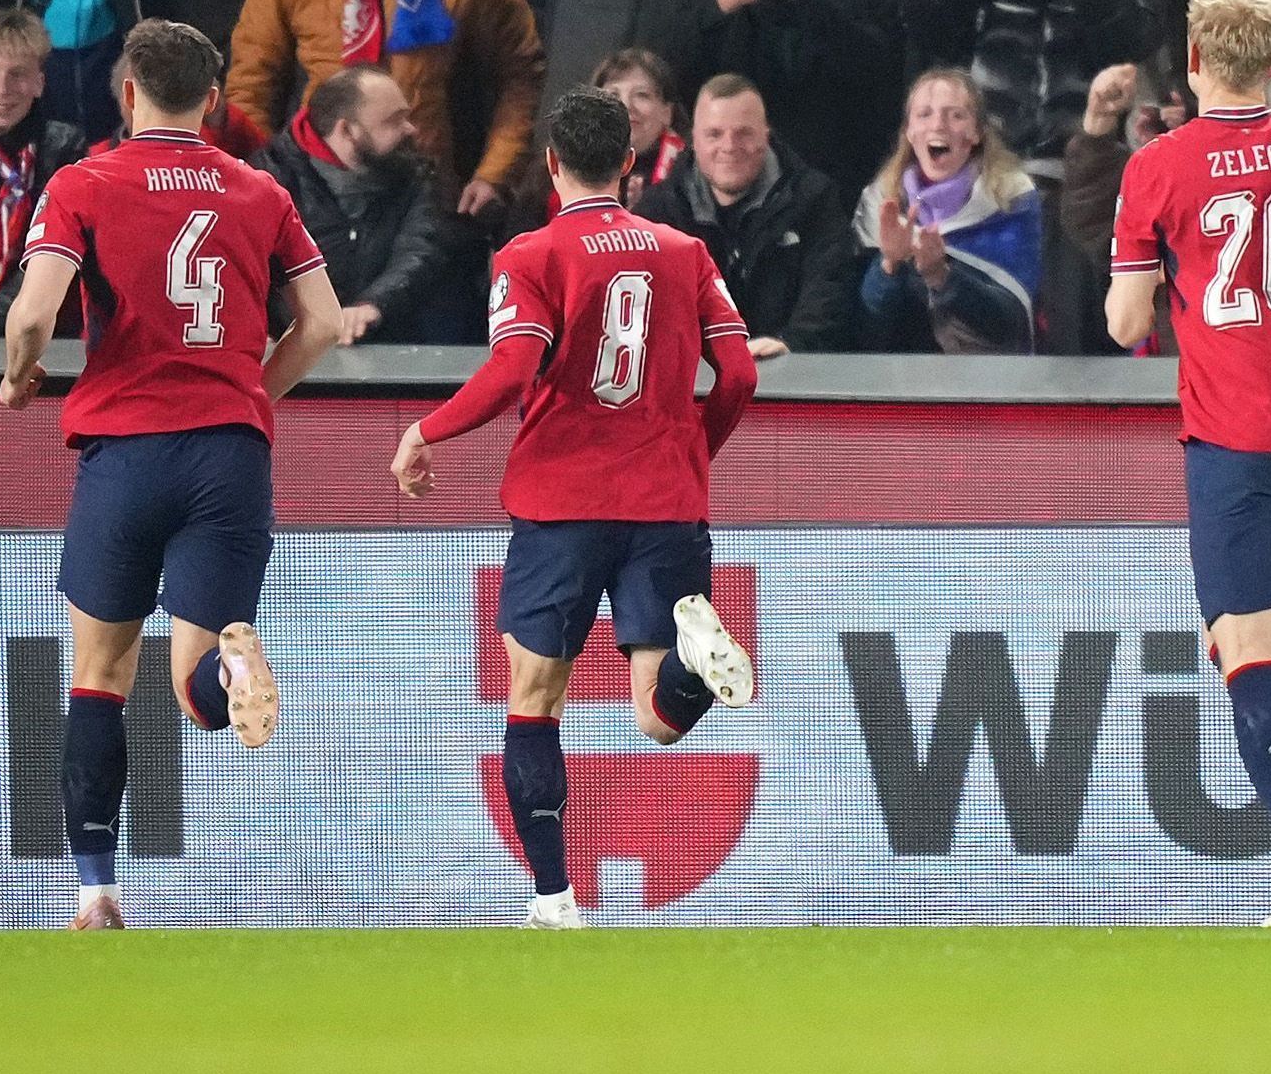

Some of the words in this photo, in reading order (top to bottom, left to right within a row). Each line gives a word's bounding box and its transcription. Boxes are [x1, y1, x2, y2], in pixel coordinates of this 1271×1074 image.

[144, 167, 227, 193] HRANÁČ
[166, 210, 227, 348] 4
[580, 228, 660, 254] DARIDA
[591, 271, 653, 410] 8
